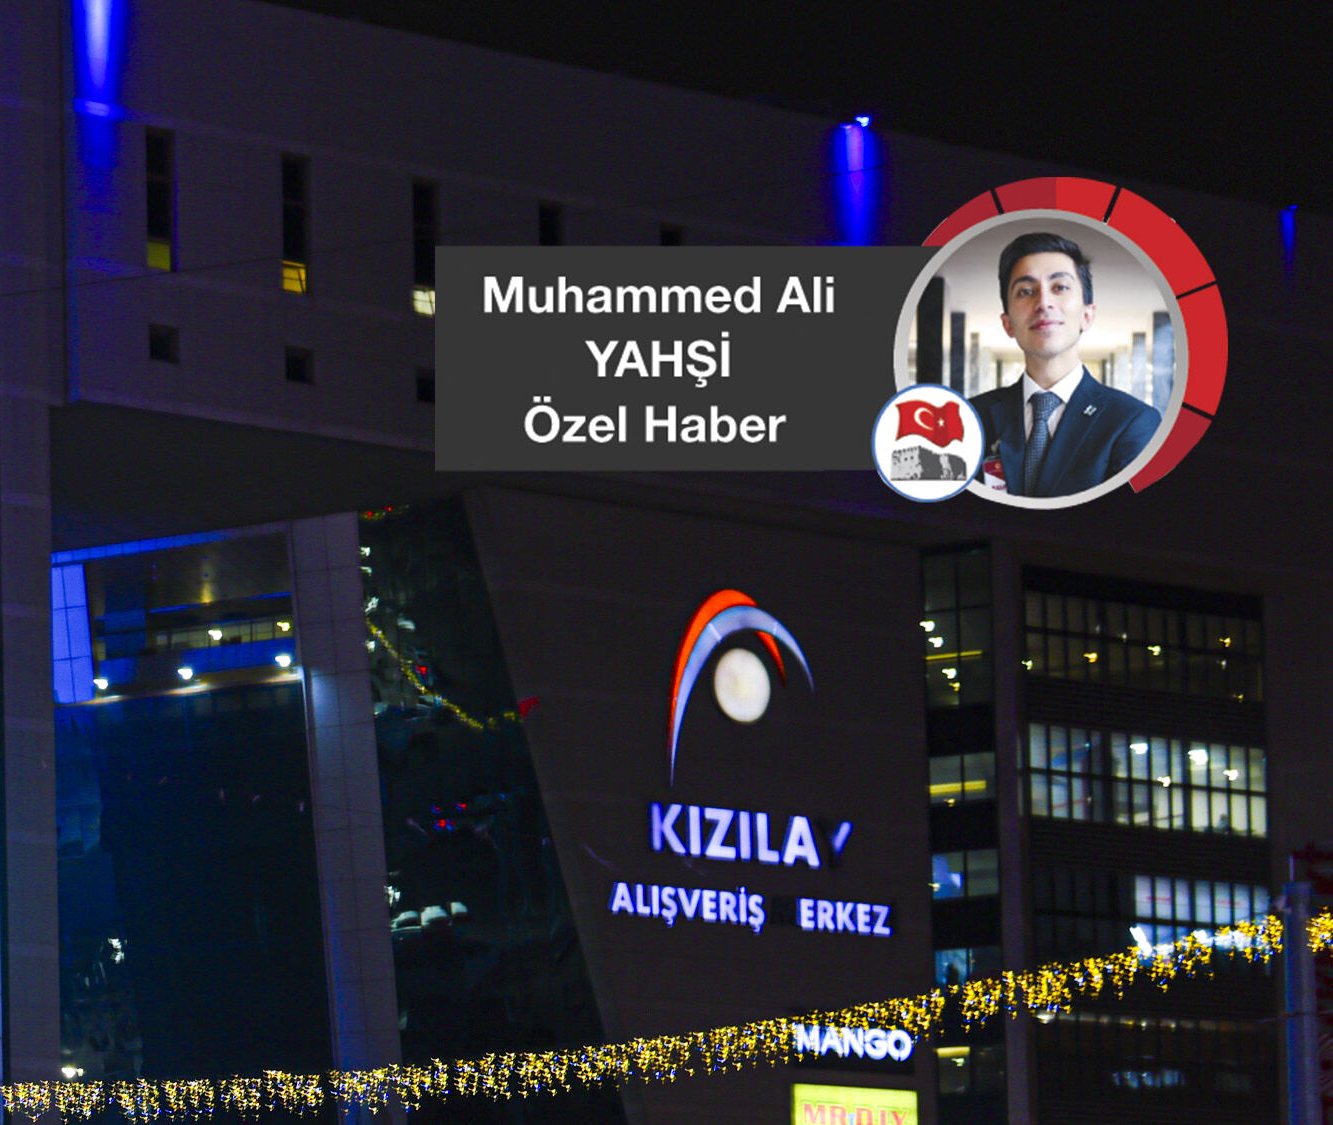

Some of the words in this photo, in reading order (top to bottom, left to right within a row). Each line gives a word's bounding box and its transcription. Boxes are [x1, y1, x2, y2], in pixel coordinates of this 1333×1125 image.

[609, 880, 768, 935] ALIŞVERİŞ
[773, 897, 893, 938] ERKEZ
[793, 1022, 914, 1062] MANGO
